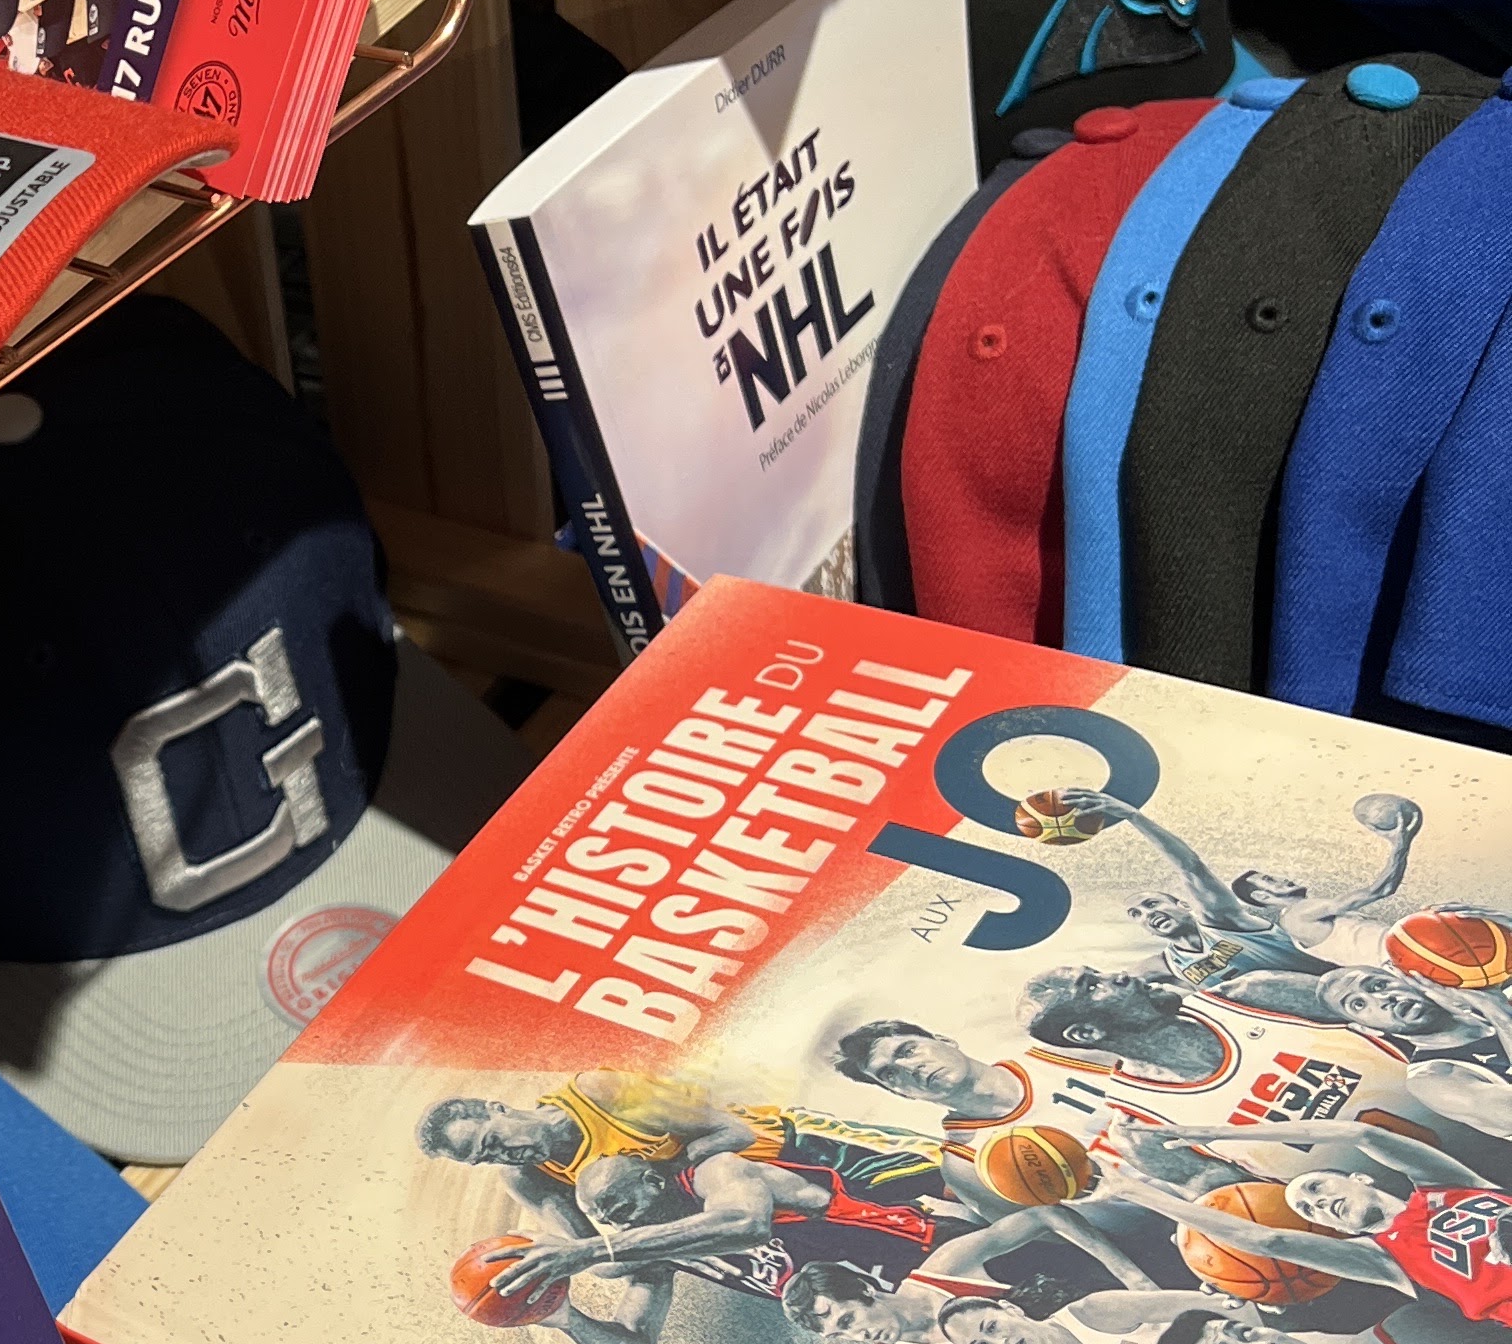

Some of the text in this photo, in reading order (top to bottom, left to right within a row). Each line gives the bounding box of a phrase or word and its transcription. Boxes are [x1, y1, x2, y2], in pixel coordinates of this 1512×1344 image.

[110, 58, 142, 102] 17
[182, 67, 223, 100] SEVEN
[714, 44, 786, 115] Didier DURR
[695, 126, 821, 273] IL ÉTAIT
[694, 234, 775, 339] UNE
[726, 240, 876, 434] NHL
[758, 376, 840, 472] Préface de Nicolas
[581, 492, 622, 557] NHL
[603, 564, 638, 605] EN
[463, 639, 825, 1004] L'HISTOIRE DU
[512, 836, 559, 883] BASKET
[551, 798, 592, 839] RETRO
[572, 659, 975, 1046] BASKETBALL
[864, 704, 1162, 953] AUX JO
